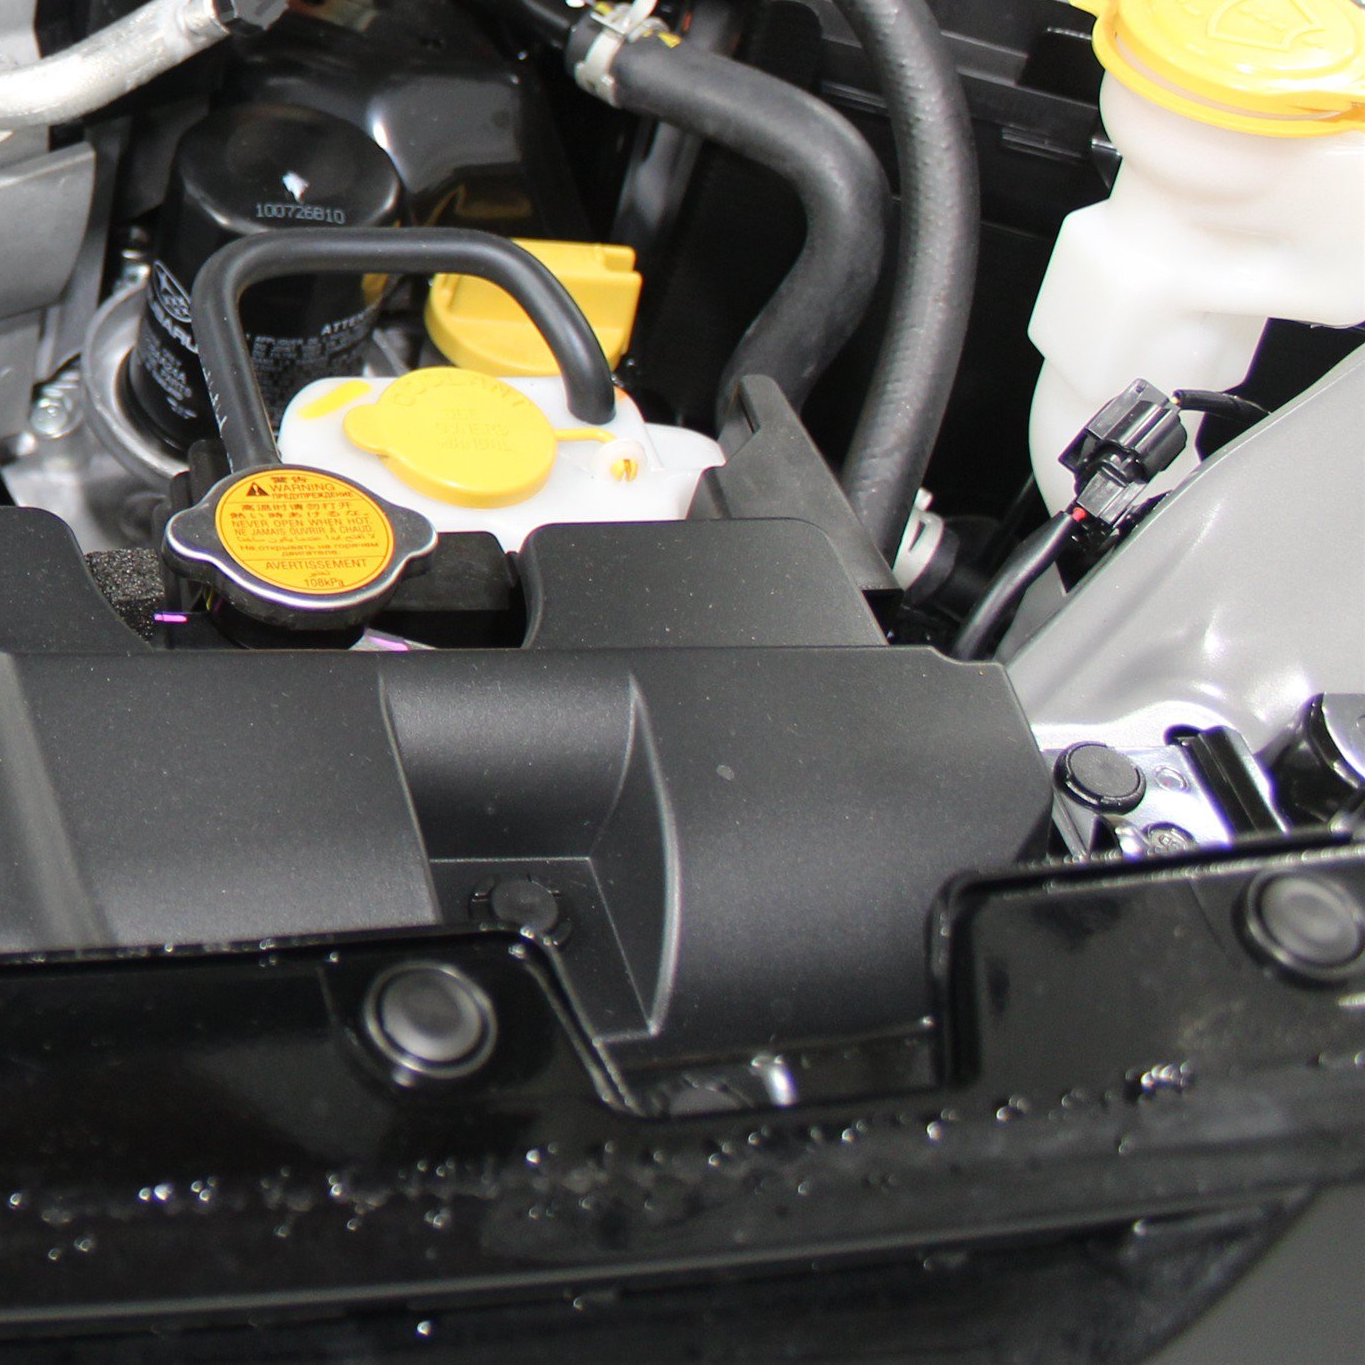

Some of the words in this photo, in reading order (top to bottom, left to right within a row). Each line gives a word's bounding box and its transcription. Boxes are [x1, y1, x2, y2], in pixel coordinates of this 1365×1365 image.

[392, 372, 527, 407] COOLANT
[269, 483, 336, 492] WARNING
[232, 520, 268, 529] NEVER
[274, 520, 304, 528] OPEN
[308, 518, 343, 527] WHEN
[251, 528, 286, 536] JAMAIS
[288, 526, 325, 536] OUVRIR
[266, 558, 368, 570] AVERTISSEMENT
[304, 578, 346, 588] 108kPa
